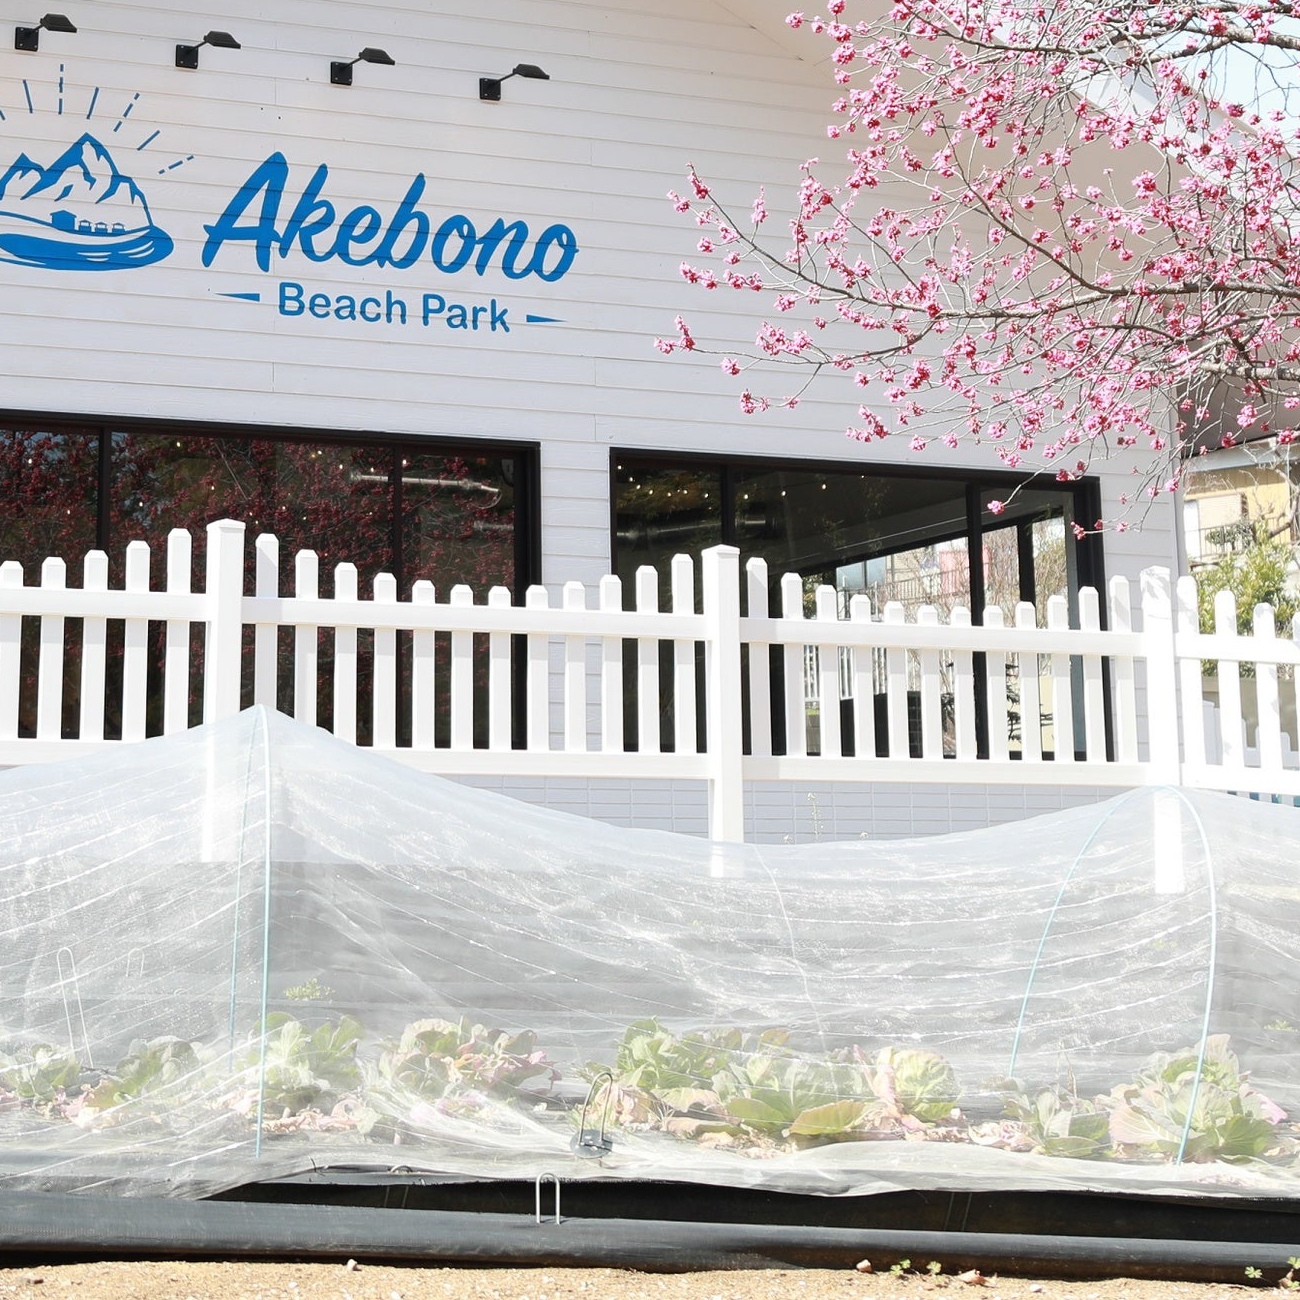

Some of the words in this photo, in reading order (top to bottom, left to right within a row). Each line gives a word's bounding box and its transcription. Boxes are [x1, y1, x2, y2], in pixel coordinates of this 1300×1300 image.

[201, 151, 580, 283] Akebono
[279, 282, 407, 325] Beach
[422, 293, 511, 332] Park
